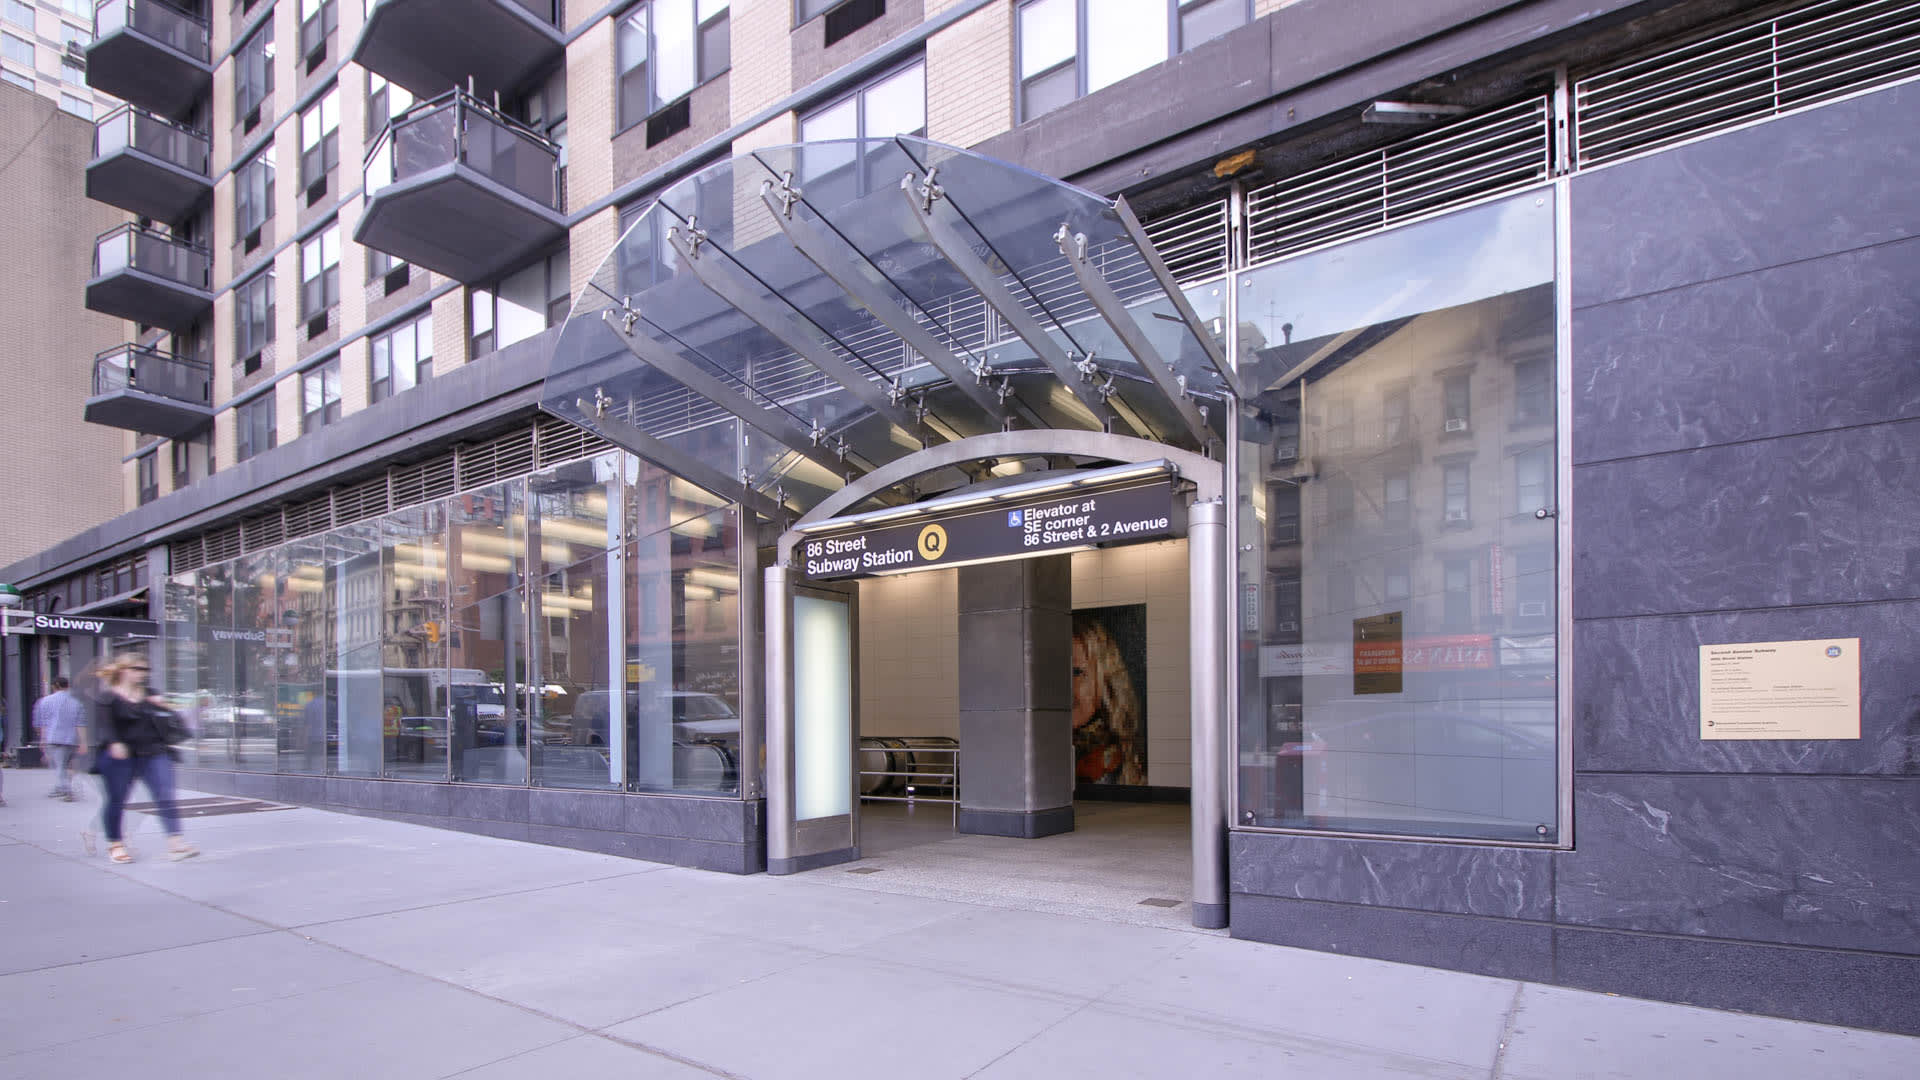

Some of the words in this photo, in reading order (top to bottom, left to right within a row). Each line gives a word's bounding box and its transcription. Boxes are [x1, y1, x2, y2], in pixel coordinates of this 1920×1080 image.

[1024, 505, 1078, 520] Elevator
[1082, 500, 1095, 511] at
[1024, 521, 1042, 533] SE
[1045, 515, 1089, 530] corner
[1024, 535, 1039, 546] 86
[1043, 529, 1083, 543] Street
[1087, 525, 1097, 537] &
[1100, 523, 1110, 536] 2
[1113, 518, 1168, 534] Avenue
[807, 542, 823, 557] 86
[826, 536, 866, 555] Street
[925, 532, 939, 552] Q
[807, 557, 860, 575] Subway
[862, 548, 913, 567] Station
[36, 615, 104, 633] Subway
